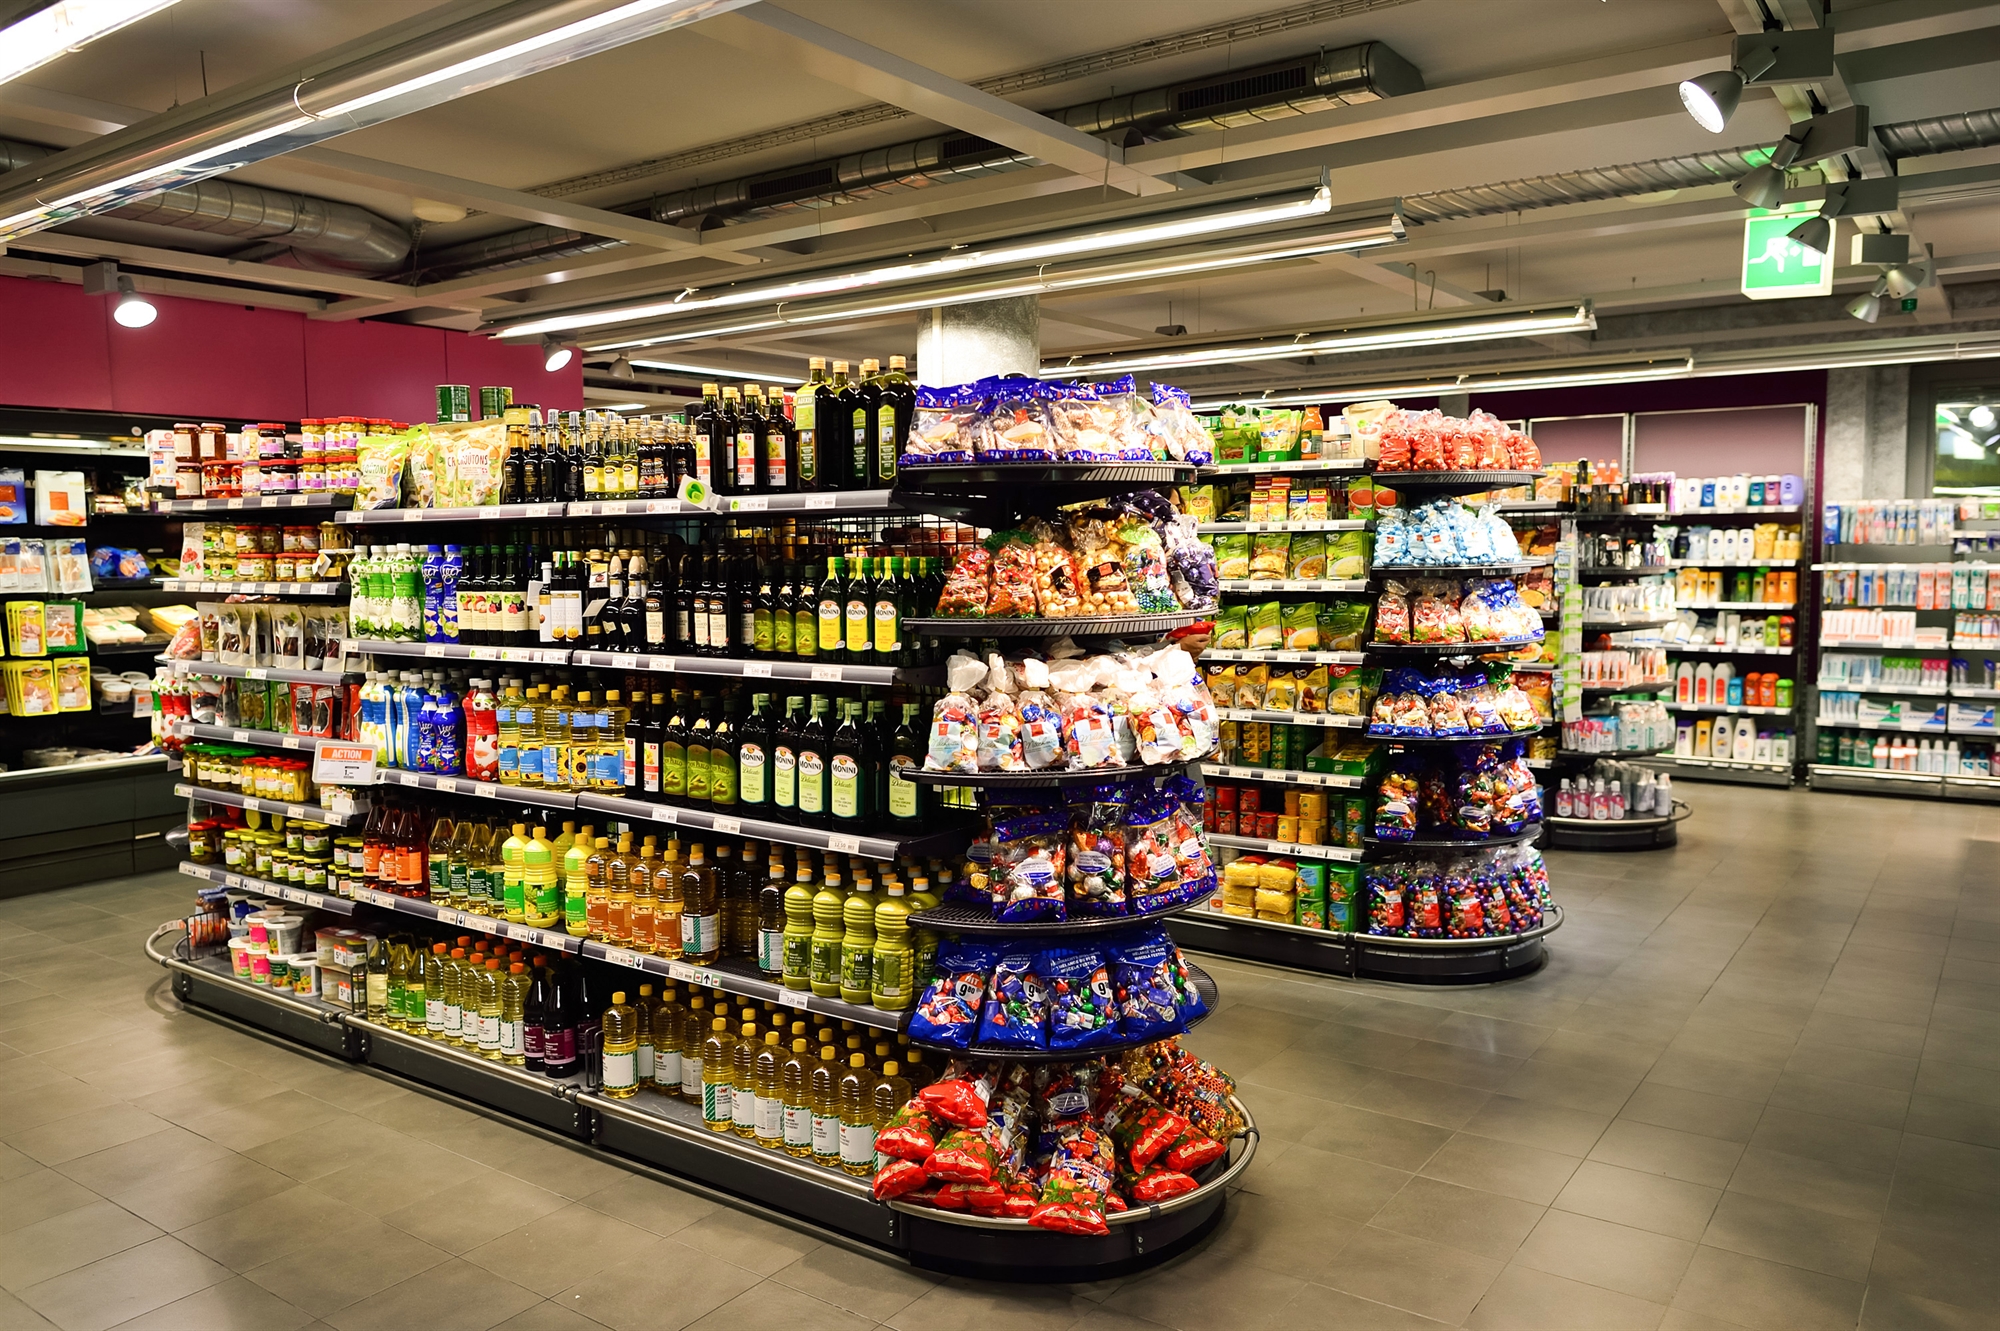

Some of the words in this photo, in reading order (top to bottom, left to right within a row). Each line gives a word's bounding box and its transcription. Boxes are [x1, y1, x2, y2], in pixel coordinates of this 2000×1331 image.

[332, 749, 362, 760] ACTION
[741, 752, 763, 761] MONINI
[775, 755, 794, 764] MONINI
[799, 760, 821, 770] MONINI
[832, 764, 856, 774] MONINI
